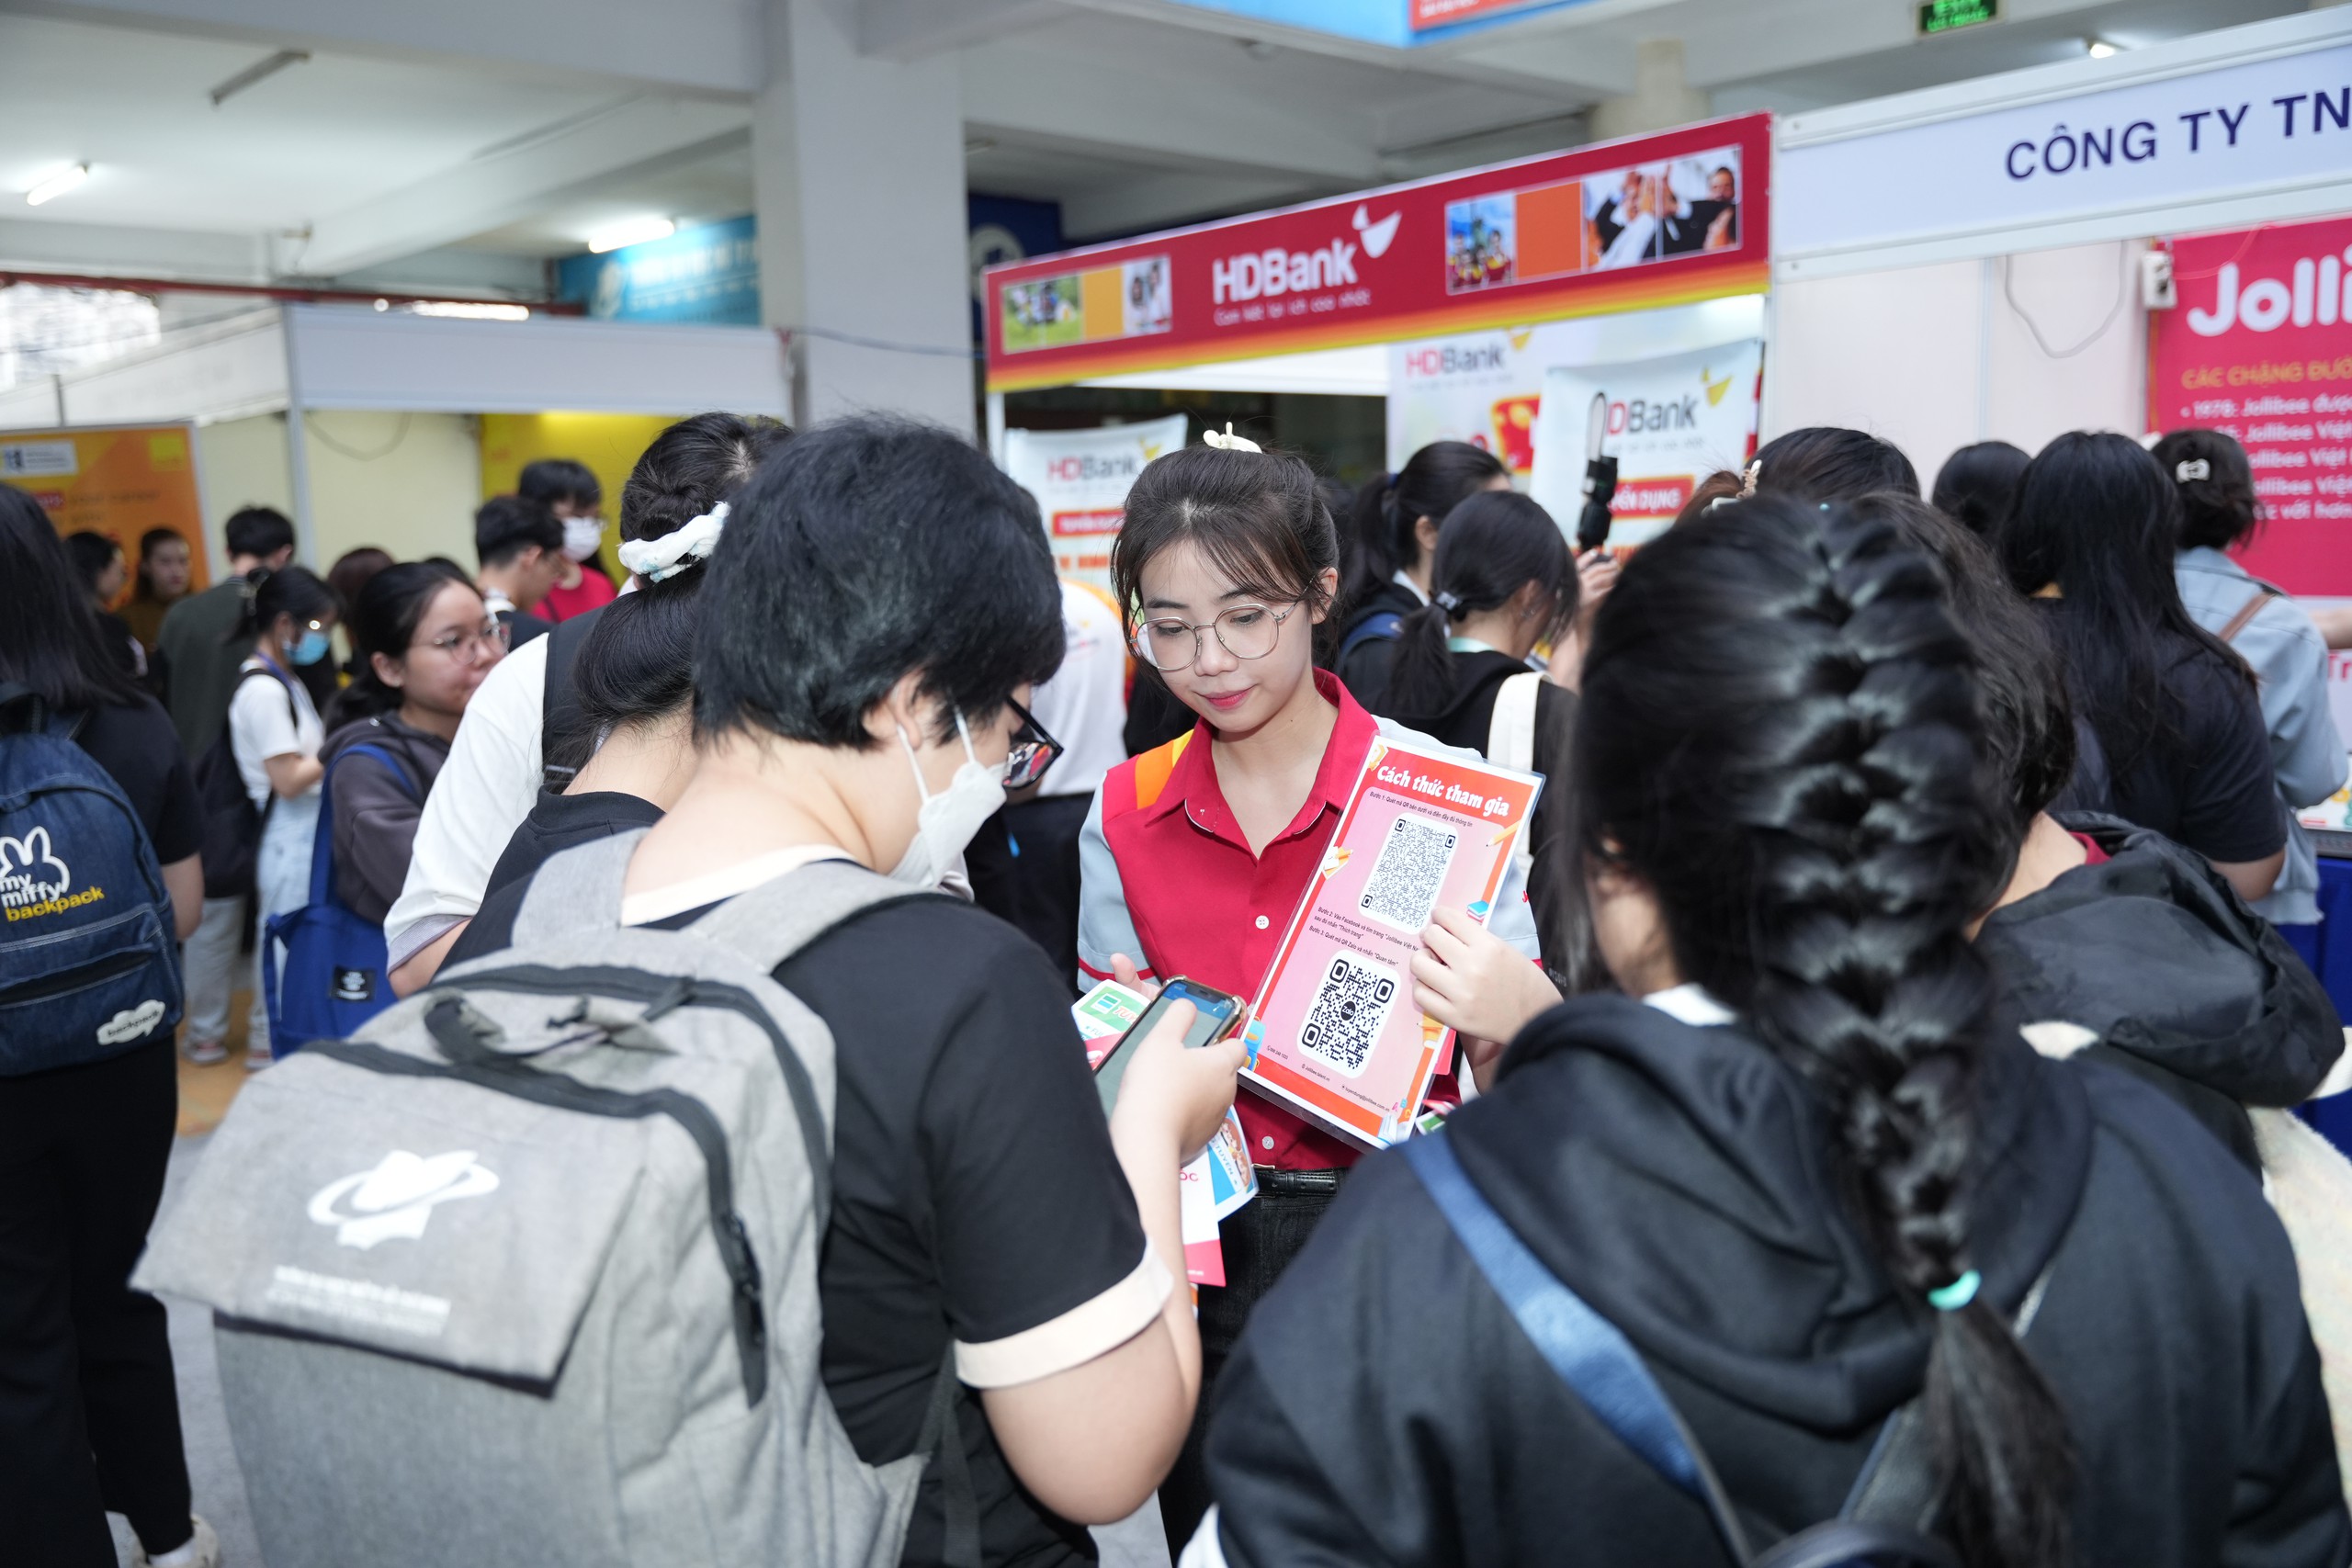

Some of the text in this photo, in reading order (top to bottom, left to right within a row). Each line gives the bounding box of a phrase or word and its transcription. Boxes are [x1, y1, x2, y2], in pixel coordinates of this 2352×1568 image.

[2005, 122, 2158, 181] CÔNG
[2178, 103, 2251, 152] TY
[1212, 237, 1359, 305] HDBank
[1406, 344, 1506, 378] HDBank
[1607, 395, 1699, 435] DBank
[1046, 455, 1136, 482] HDBank
[2247, 447, 2308, 470] ollibee
[2254, 475, 2313, 497] ollibee
[1377, 765, 1510, 818] Cách thức tham gia
[0, 873, 32, 894] my
[1, 880, 62, 908] miffy
[5, 885, 106, 923] backpack
[1341, 917, 1360, 928] Facebook
